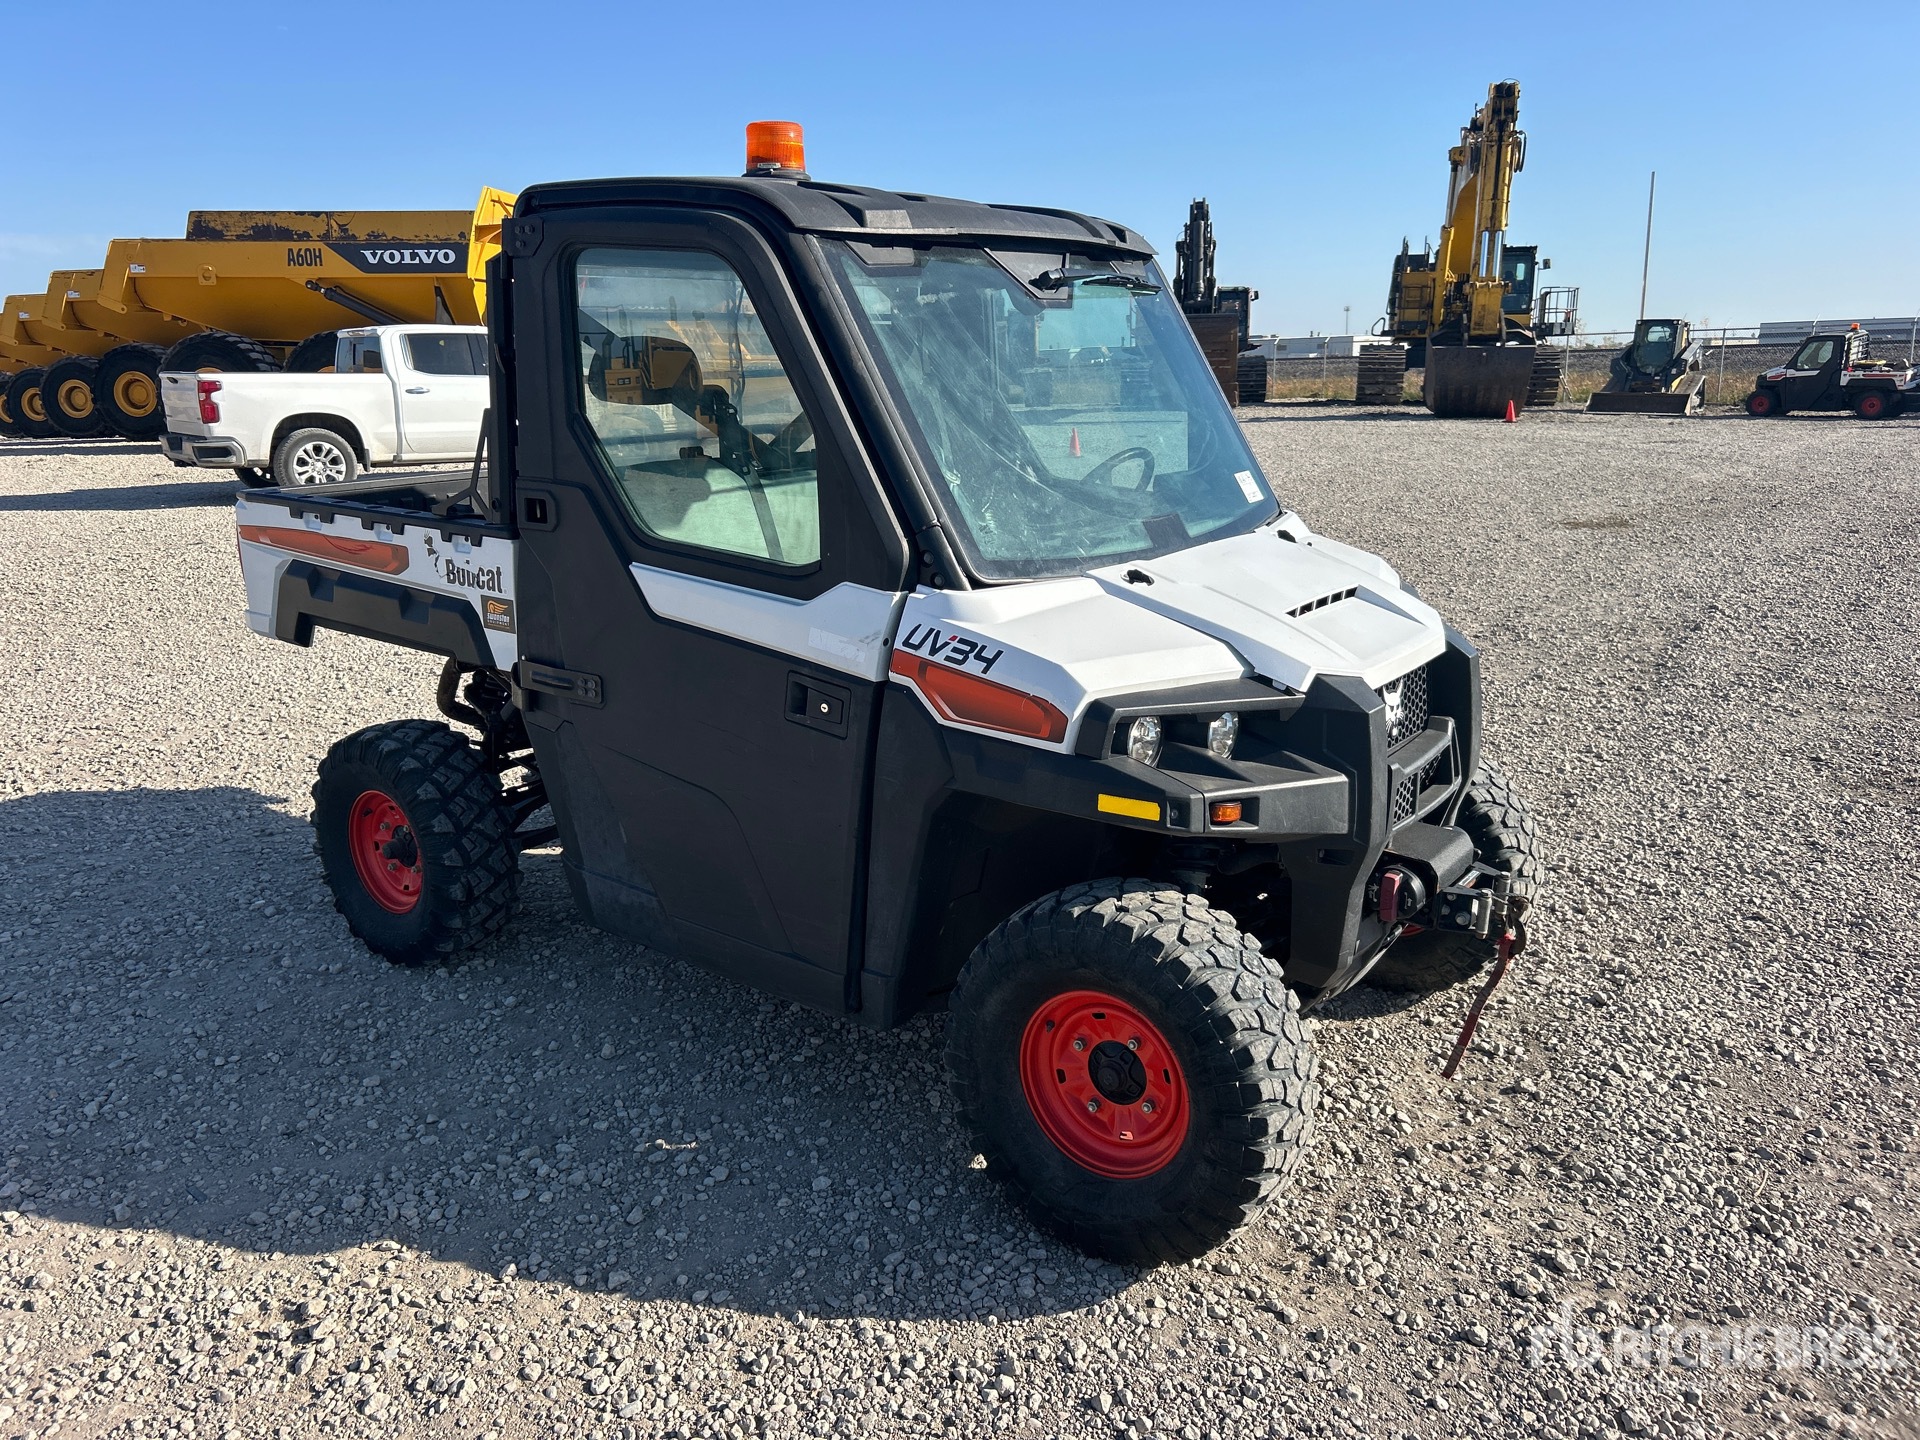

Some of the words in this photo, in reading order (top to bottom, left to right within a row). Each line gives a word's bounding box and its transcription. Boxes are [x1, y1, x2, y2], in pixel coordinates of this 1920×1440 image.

[287, 247, 323, 267] A60H
[360, 249, 456, 264] VOLVO
[445, 558, 503, 594] Bobcat
[901, 623, 1005, 675] UV34
